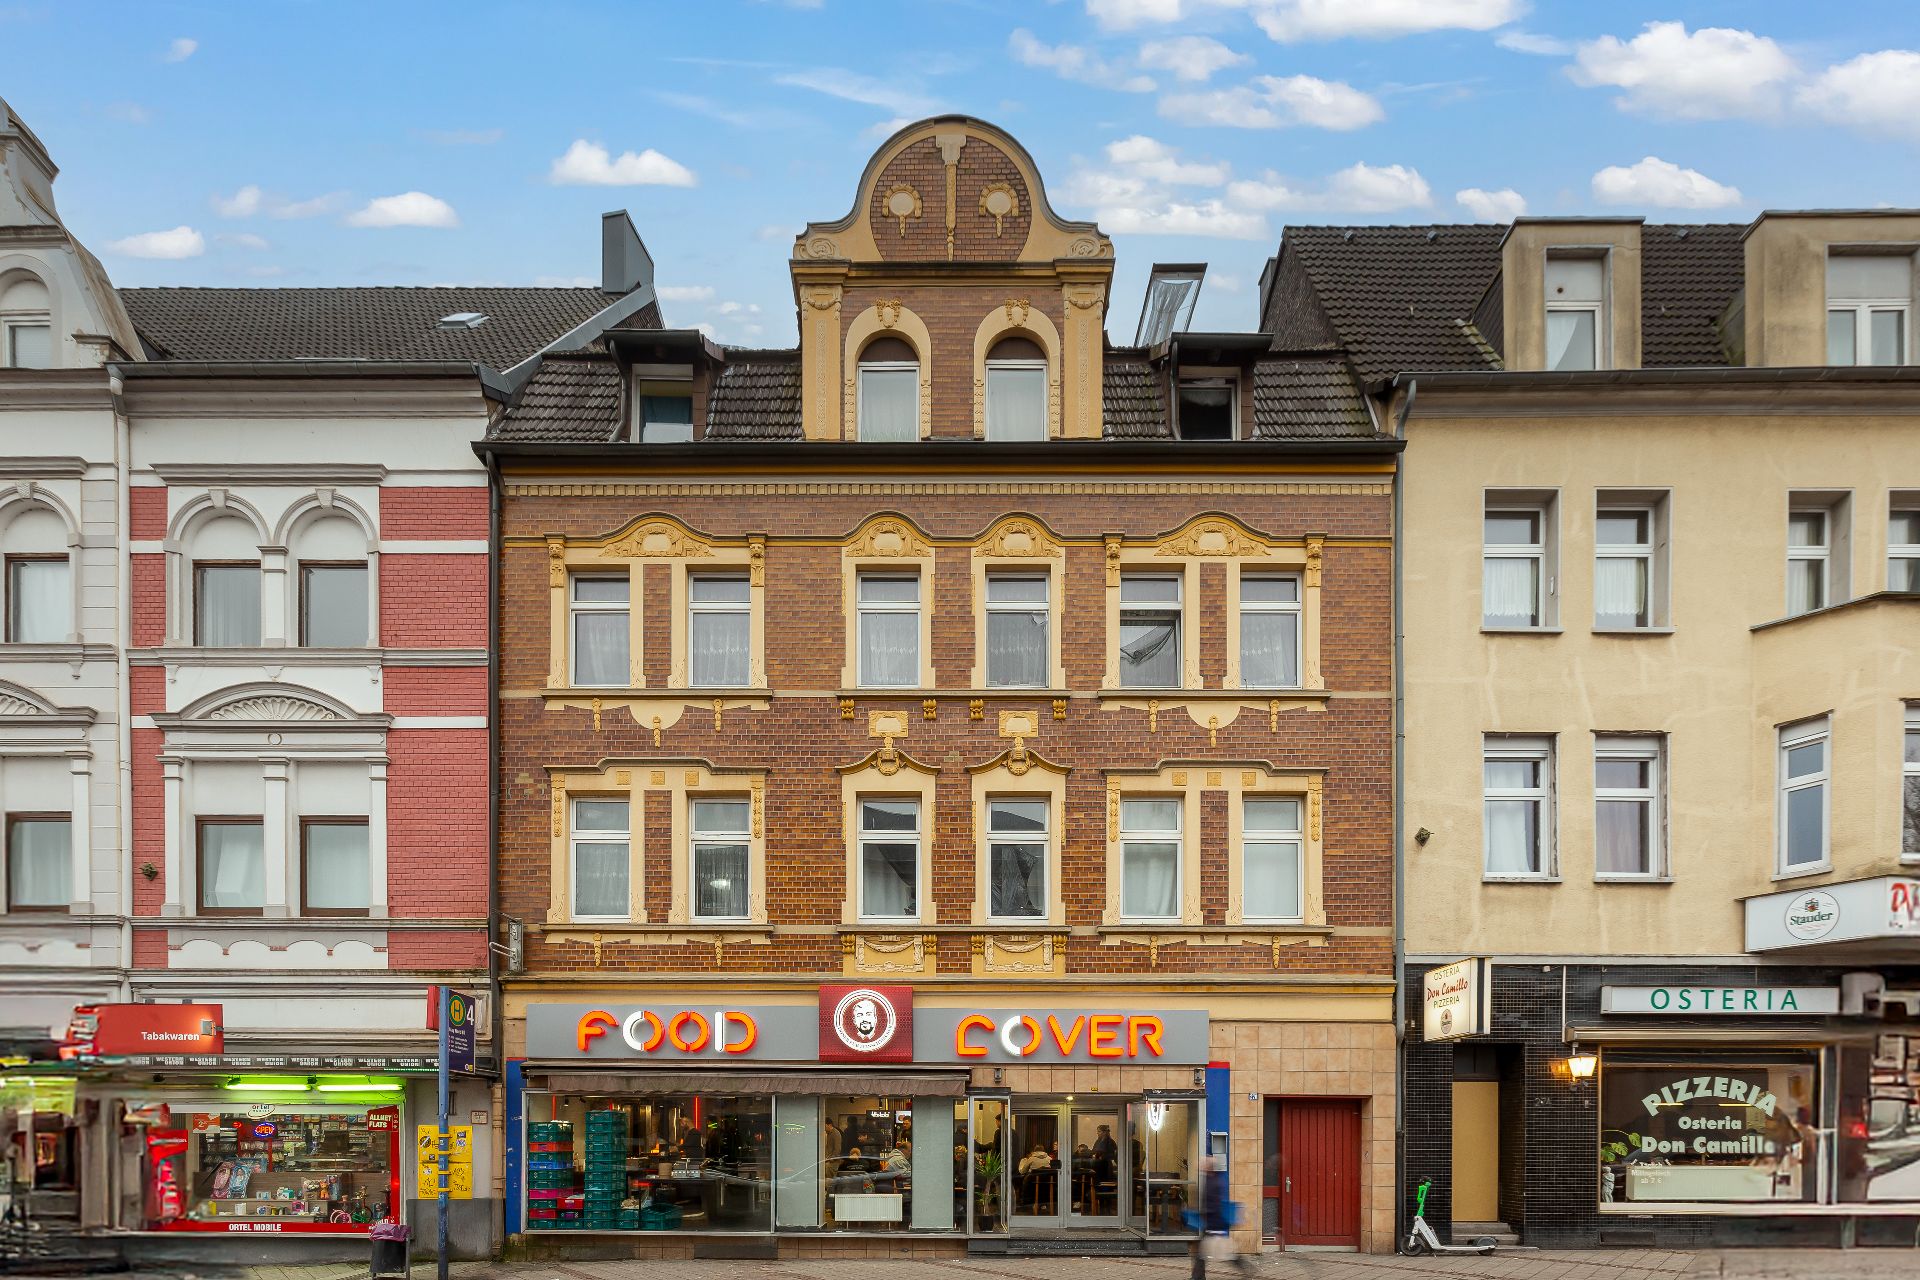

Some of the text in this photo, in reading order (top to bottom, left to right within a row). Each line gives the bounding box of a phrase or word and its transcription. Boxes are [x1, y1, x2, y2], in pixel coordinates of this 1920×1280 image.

[1790, 911, 1834, 926] Stauder
[1434, 966, 1460, 980] OSTERIA
[1427, 977, 1468, 1002] Don Camillo
[1434, 995, 1460, 1008] PIZZERIA
[1650, 988, 1798, 1010] OSTERIA
[466, 1004, 475, 1026] 4
[141, 1031, 200, 1041] Tabakwaren
[577, 1010, 759, 1054] FOOD
[956, 1014, 1165, 1057] COVER
[1641, 1076, 1777, 1118] PIZZERIA
[370, 1114, 392, 1122] ALLNET
[1678, 1115, 1742, 1130] Osteria
[256, 1126, 273, 1134] OPEN
[1642, 1136, 1686, 1154] Don
[254, 1224, 282, 1232] MOBILE
